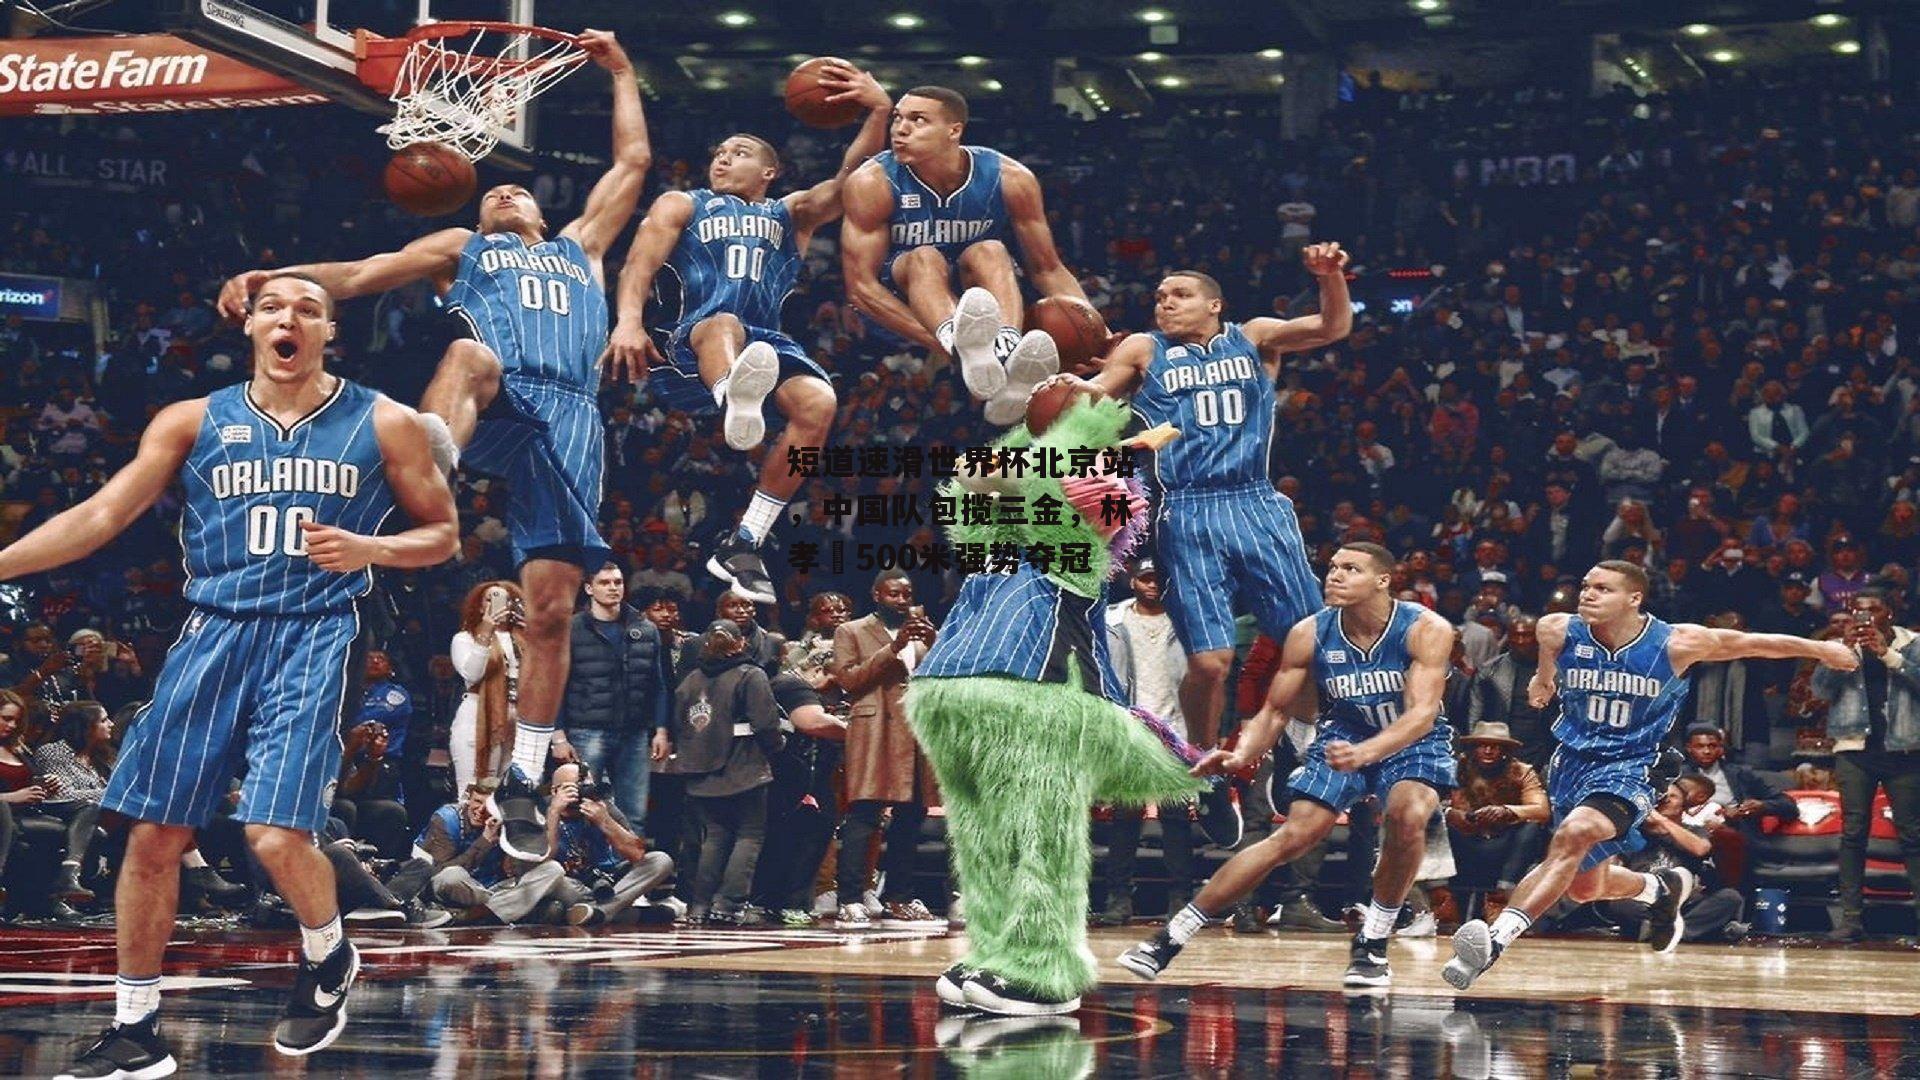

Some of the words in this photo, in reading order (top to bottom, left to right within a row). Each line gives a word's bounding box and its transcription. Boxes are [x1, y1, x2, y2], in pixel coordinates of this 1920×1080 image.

[98, 157, 168, 186] STAR
[727, 244, 765, 283] 00
[519, 273, 570, 316] 00
[1195, 388, 1244, 427] 00
[211, 457, 360, 499] ORLANDO
[248, 504, 315, 557] 00
[1566, 668, 1661, 698] ORLANDO
[1588, 694, 1631, 729] 00
